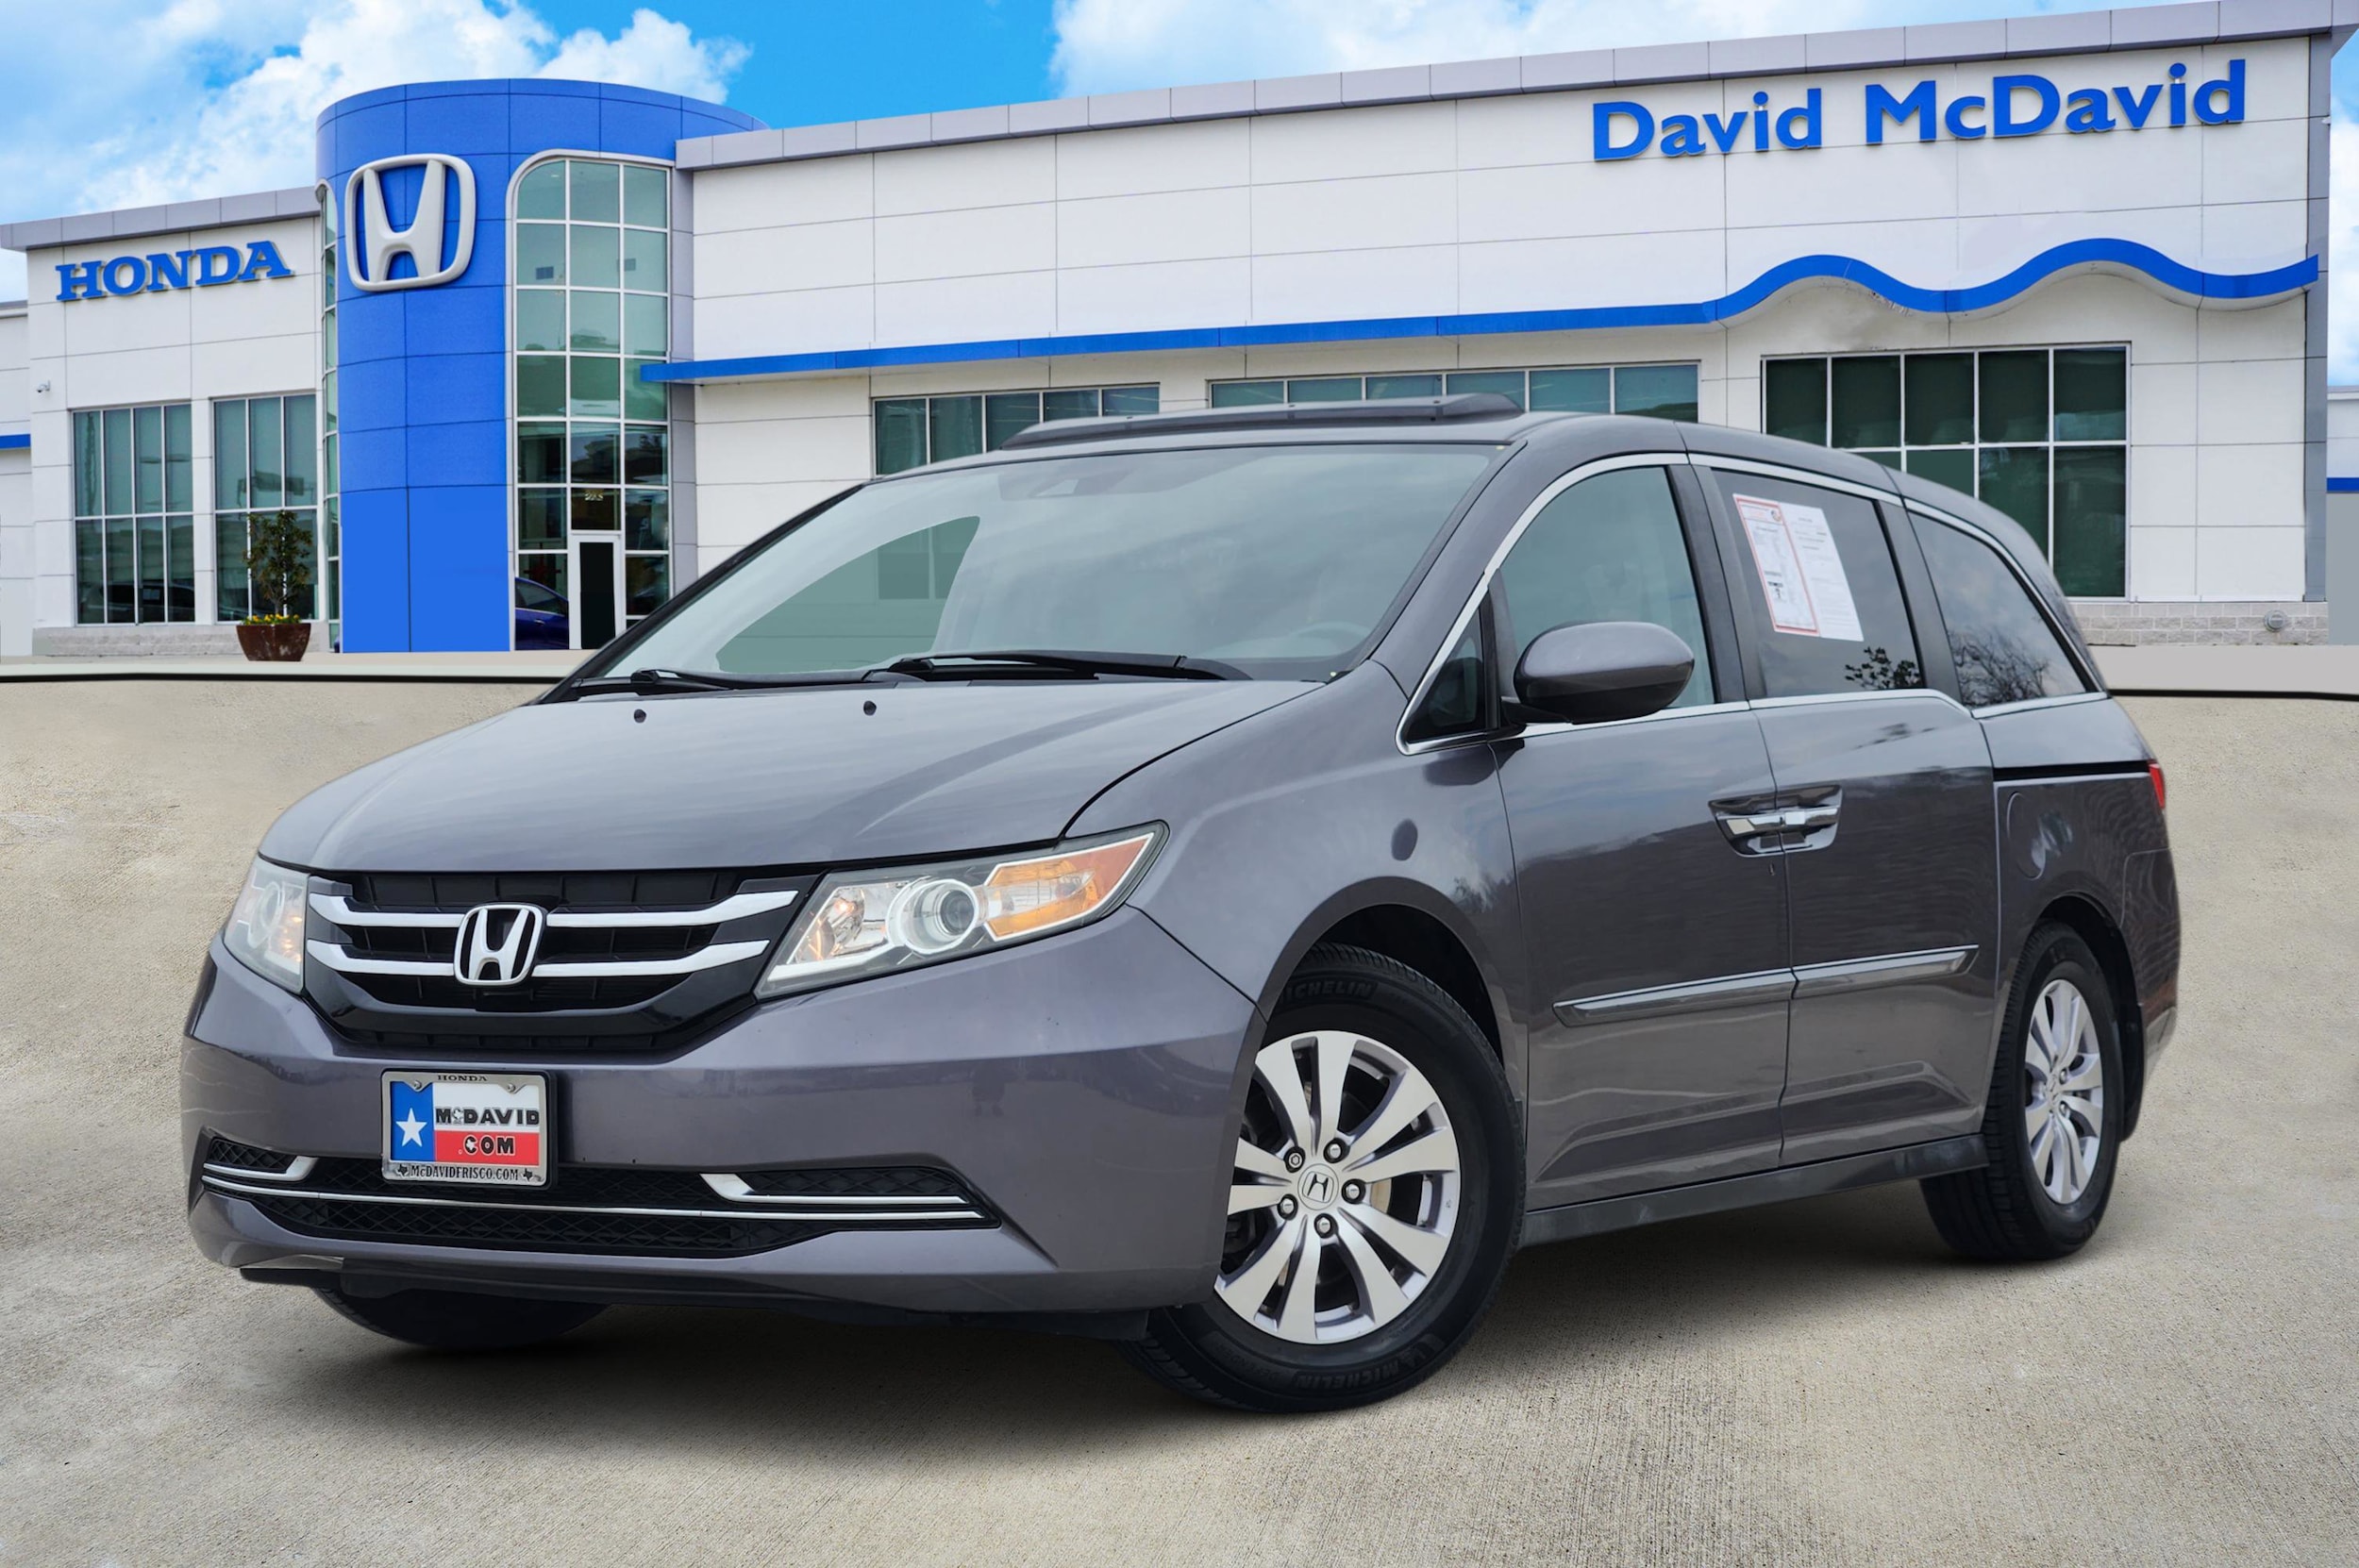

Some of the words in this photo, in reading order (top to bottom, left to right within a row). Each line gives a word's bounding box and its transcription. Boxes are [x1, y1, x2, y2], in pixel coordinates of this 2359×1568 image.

[1593, 87, 1822, 161] David
[1865, 58, 2247, 145] McDavid
[55, 240, 293, 301] HONDA
[1296, 1359, 1399, 1389] MICHELIN
